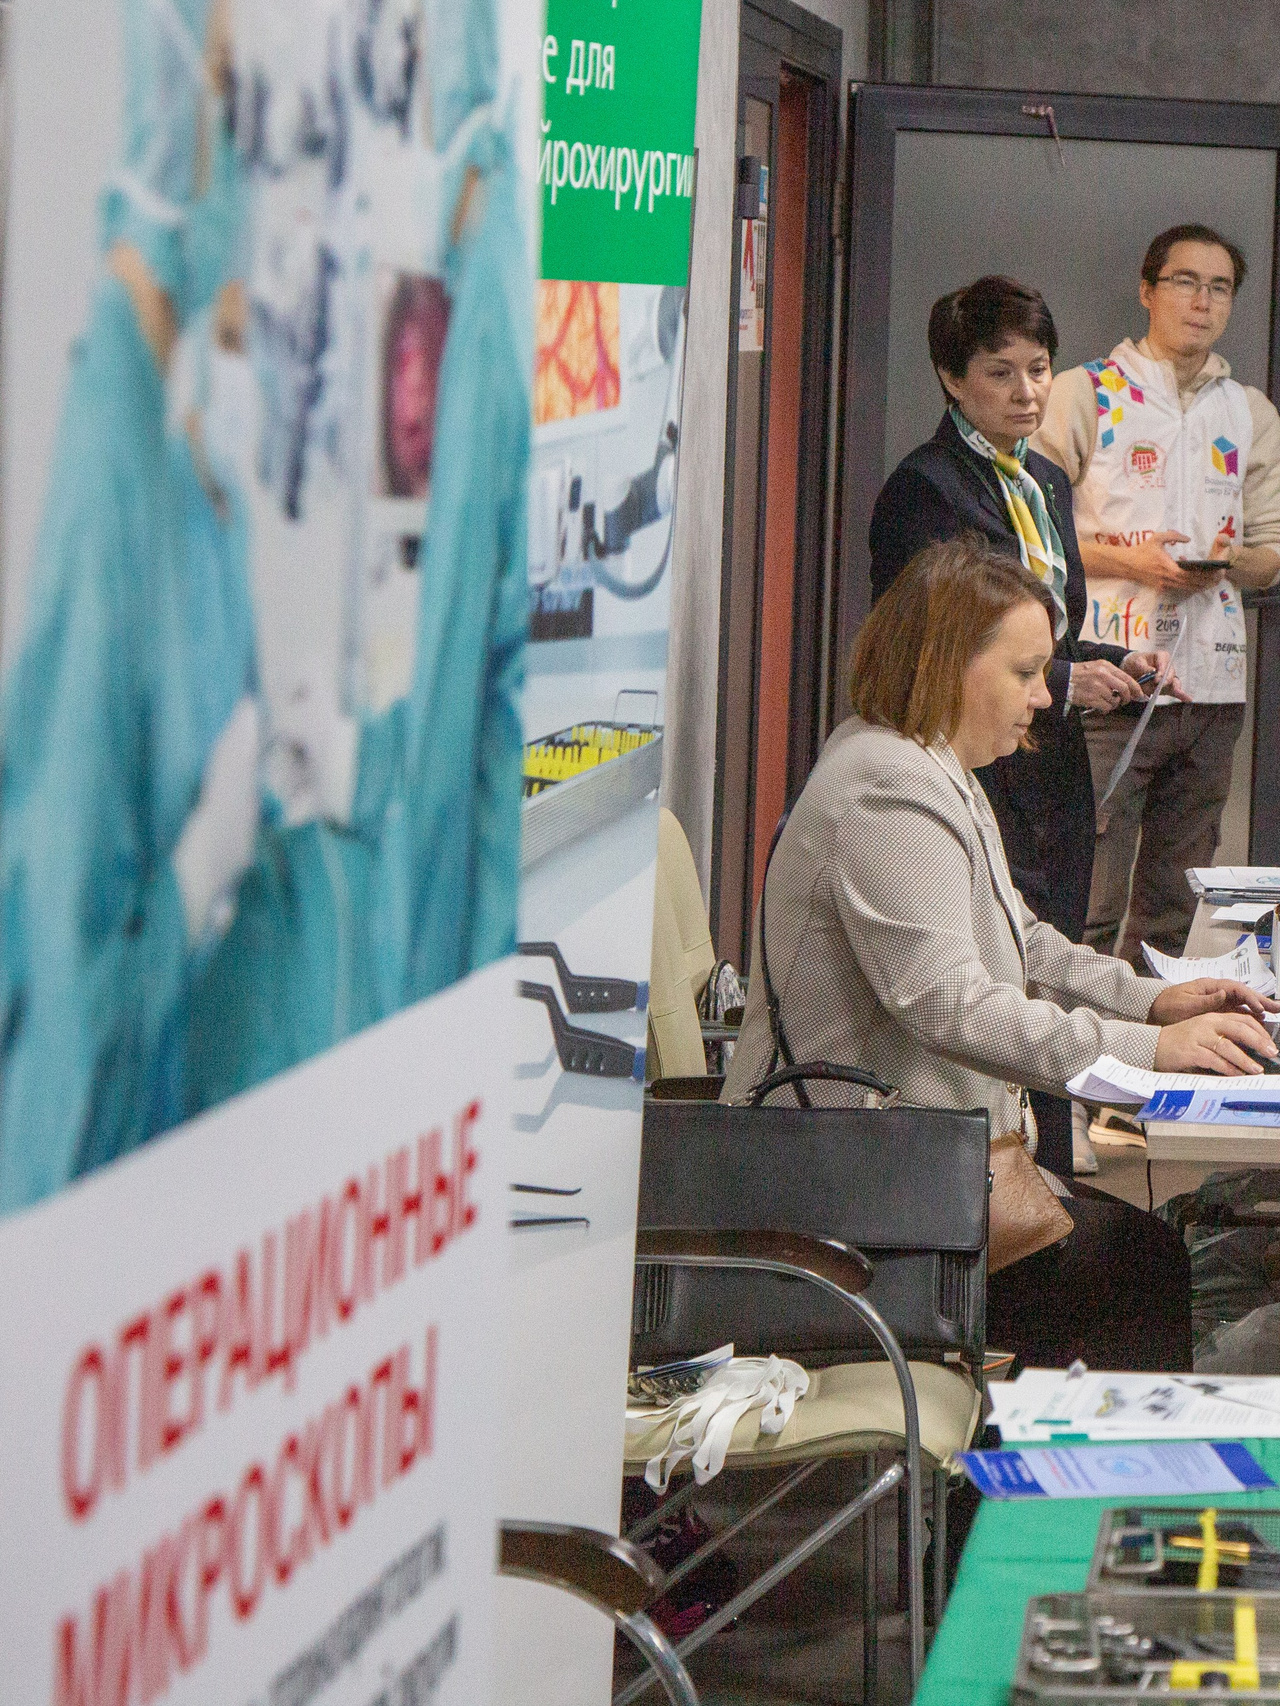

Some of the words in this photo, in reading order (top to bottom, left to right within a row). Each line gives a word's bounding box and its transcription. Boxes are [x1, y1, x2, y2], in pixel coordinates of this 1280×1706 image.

[566, 39, 616, 95] для
[1156, 618, 1180, 632] 2019
[60, 1098, 482, 1523] ОПЕРАЦИОННЫЕ
